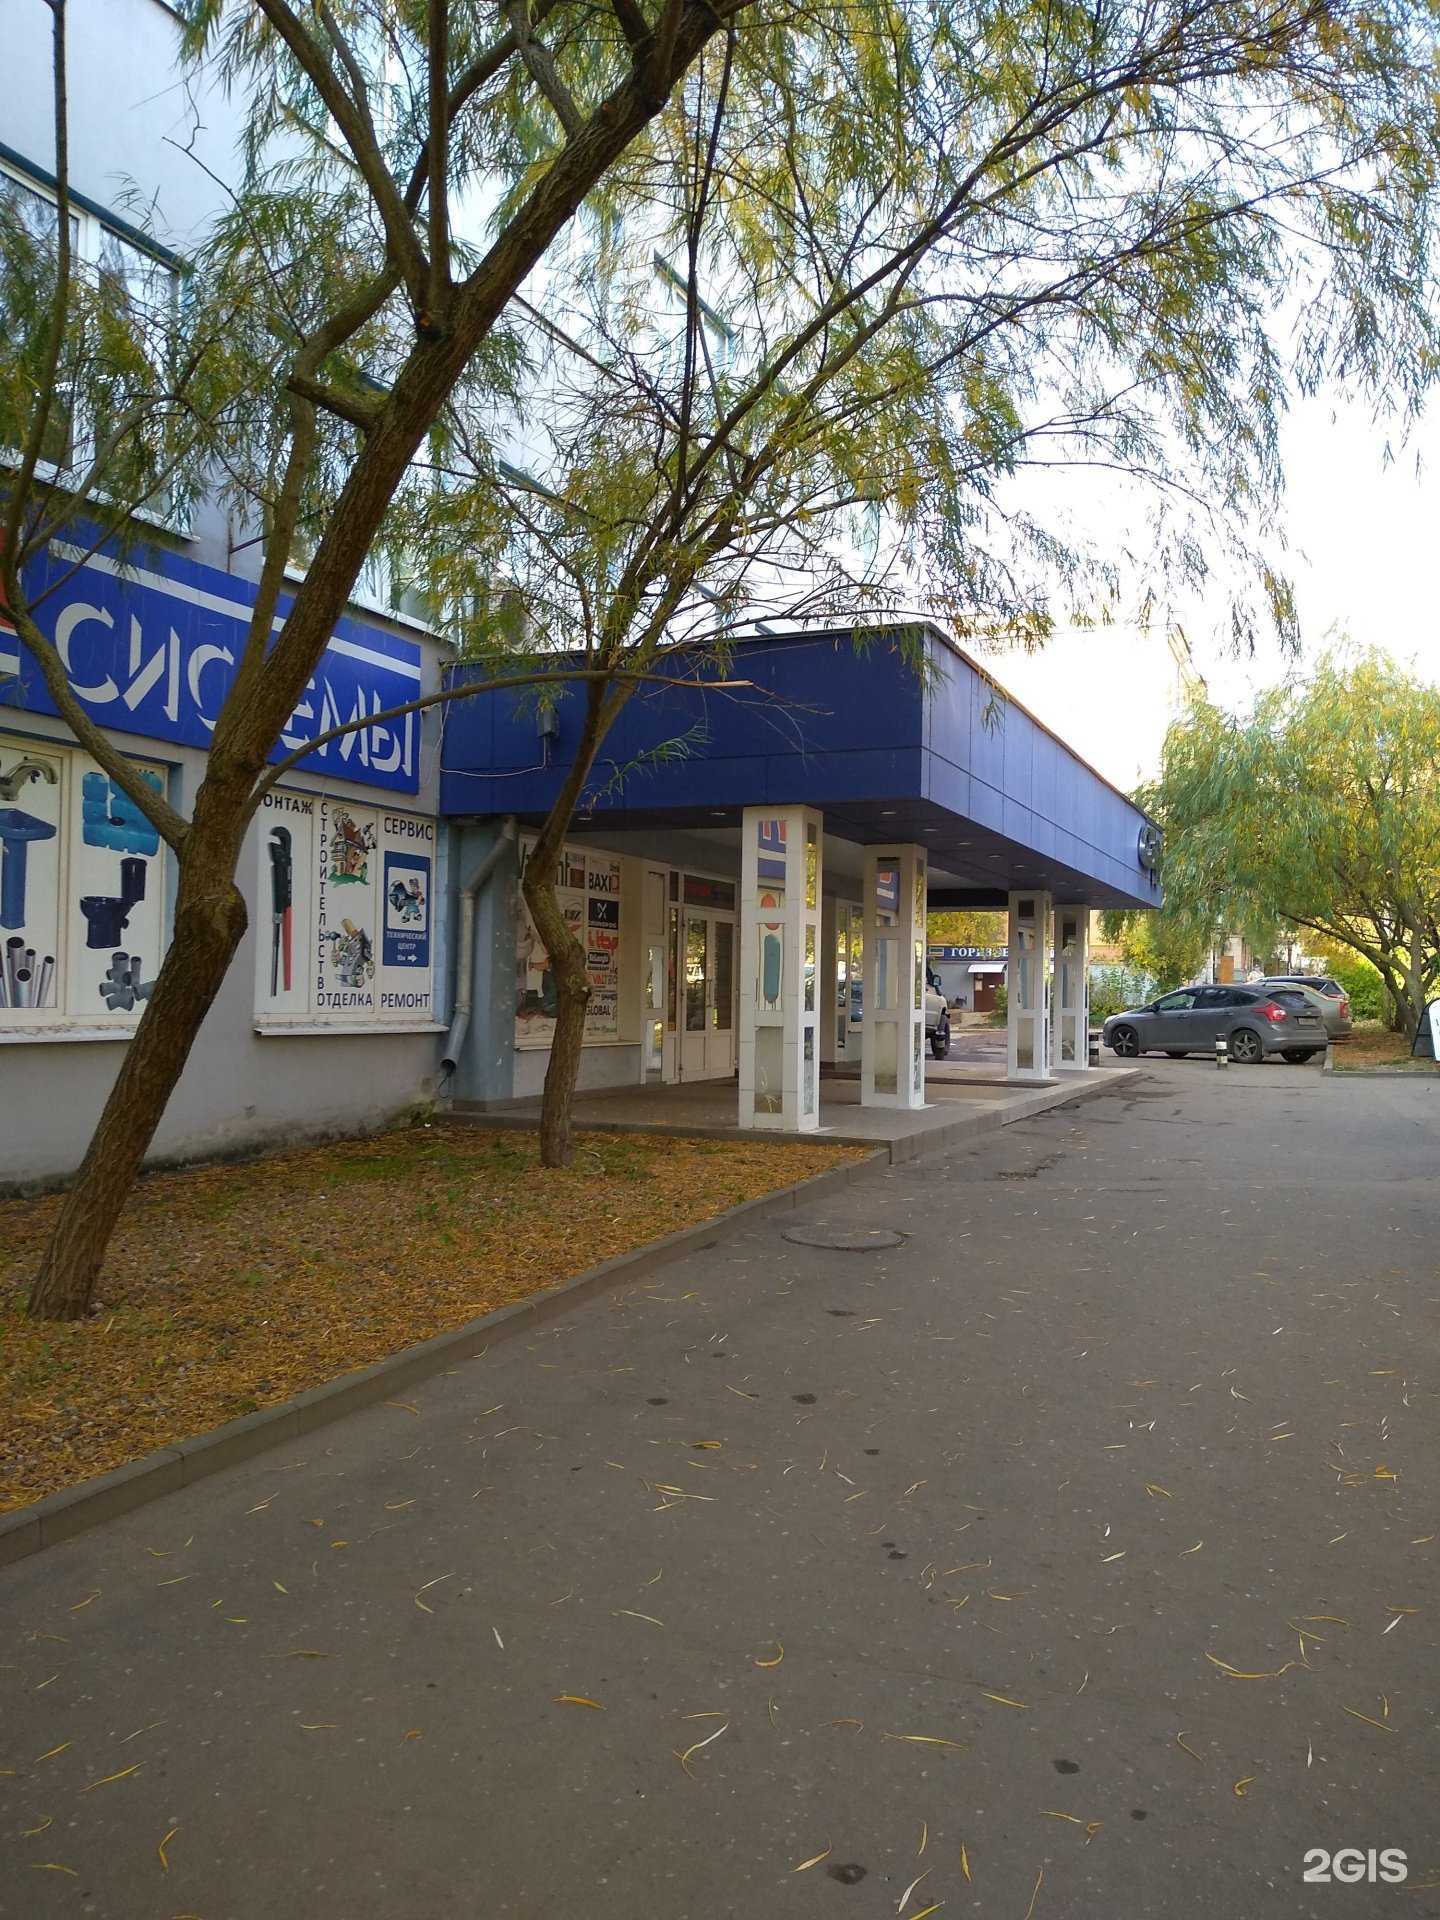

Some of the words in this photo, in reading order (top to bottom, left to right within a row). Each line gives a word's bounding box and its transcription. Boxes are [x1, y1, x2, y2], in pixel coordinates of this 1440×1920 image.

[55, 602, 412, 777] СИСЕМЫ
[262, 793, 313, 814] ОНТАЖ
[384, 817, 433, 841] СЕРВИС
[317, 992, 373, 1009] ОТДЕЛКА
[381, 993, 431, 1008] РЕМОНТ
